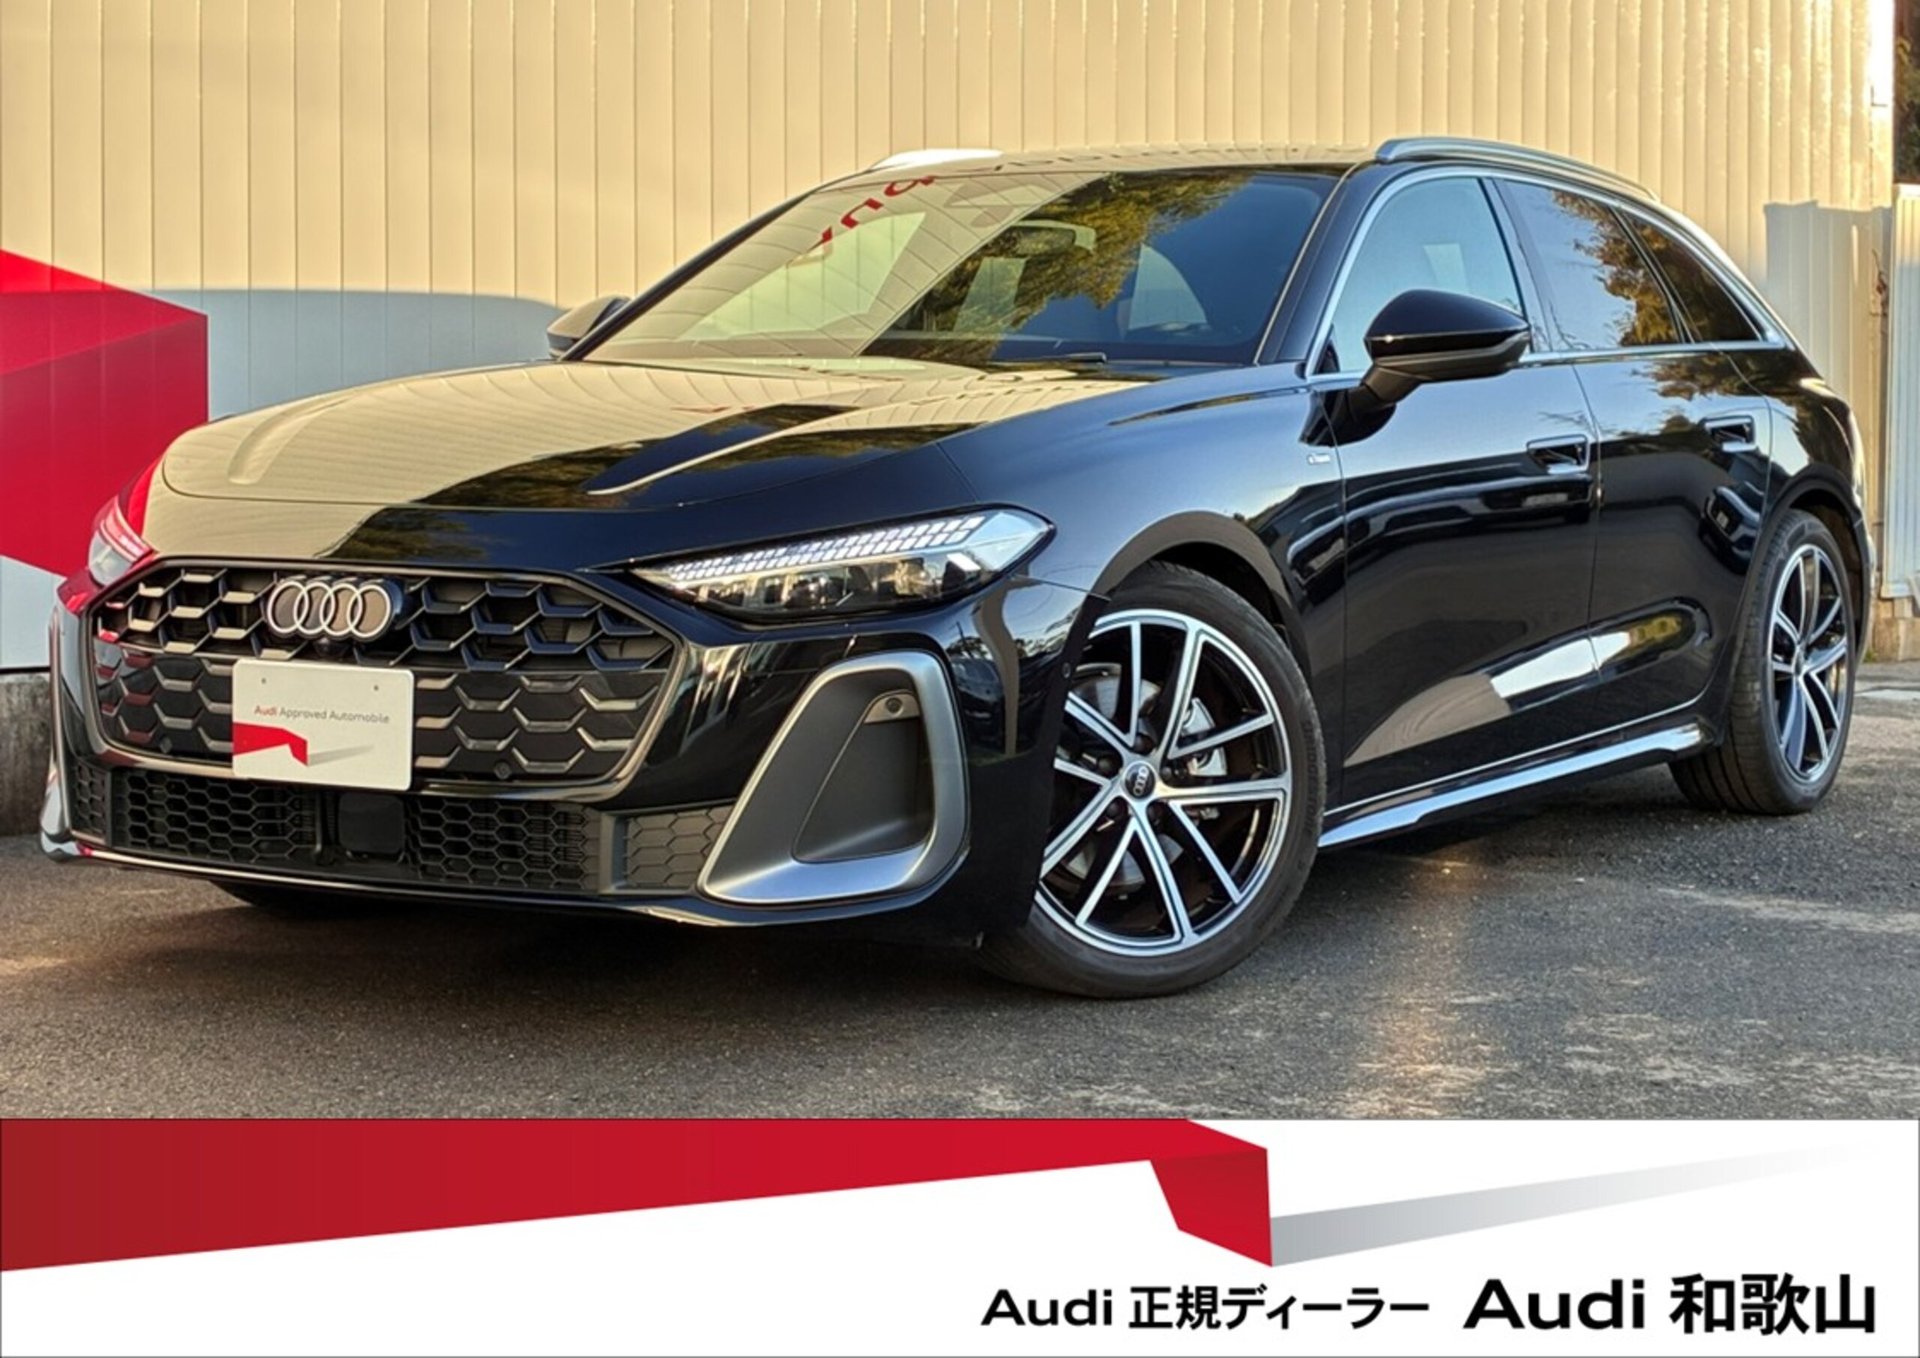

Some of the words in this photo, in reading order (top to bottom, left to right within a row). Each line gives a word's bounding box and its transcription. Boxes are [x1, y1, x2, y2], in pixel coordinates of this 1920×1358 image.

[254, 705, 277, 716] Audi
[279, 707, 327, 720] Approved
[329, 710, 389, 723] Automobile
